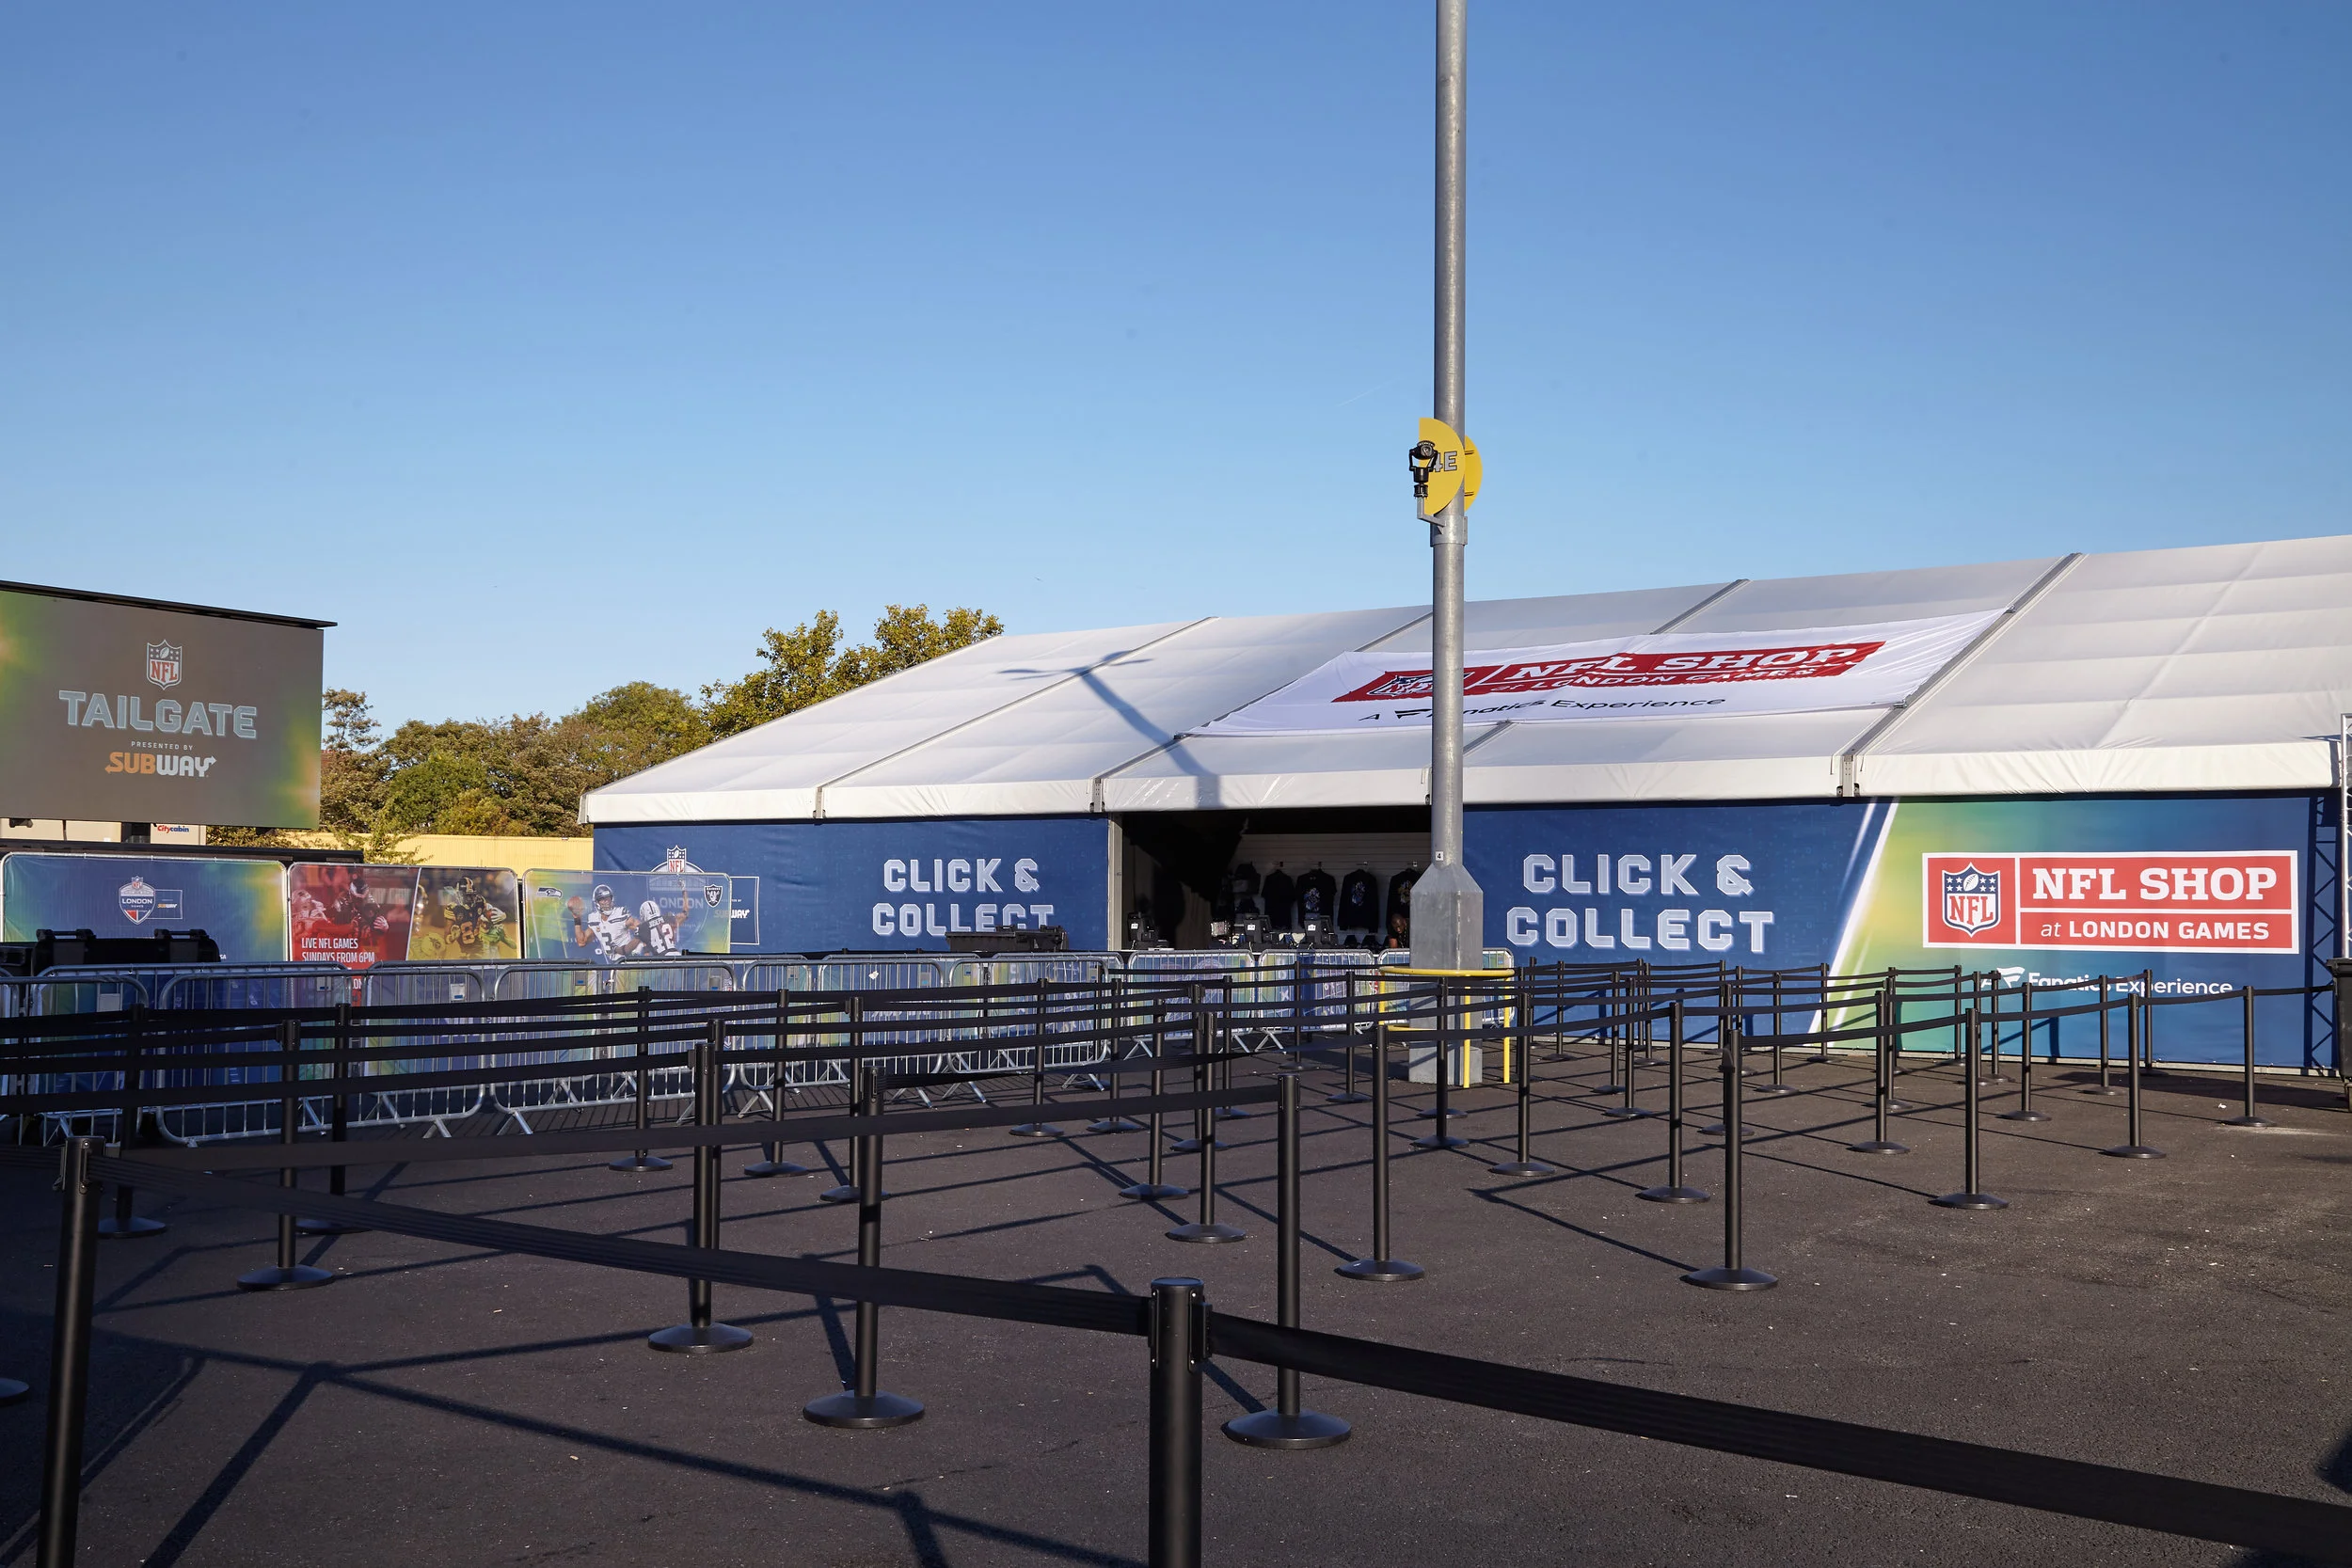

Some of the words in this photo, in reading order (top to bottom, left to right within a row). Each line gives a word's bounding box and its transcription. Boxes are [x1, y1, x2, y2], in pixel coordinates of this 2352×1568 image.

[151, 660, 178, 683] NFL
[1504, 656, 1637, 680] NFL
[1654, 649, 1857, 671] SHOP
[1531, 675, 1677, 688] LONDON
[59, 690, 257, 738] TAILGATE
[1426, 700, 1546, 717] natics
[1550, 699, 1725, 710] Experience
[132, 741, 180, 750] PRESENTED
[105, 752, 216, 777] SUBWAY
[157, 825, 189, 833] Citycabin
[669, 860, 685, 873] NFL
[883, 858, 1003, 893] CLICK
[1014, 858, 1041, 893] &
[1523, 853, 1699, 895] CLICK
[1716, 854, 1755, 895] &
[2033, 867, 2126, 900] NFL
[2139, 867, 2277, 901] SHOP
[872, 903, 1054, 936] COLLECT
[1949, 895, 1994, 927] NFL
[1506, 907, 1774, 953] COLLECT
[2041, 922, 2061, 937] at
[2070, 921, 2169, 939] LONDON
[2178, 922, 2269, 940] GAMES
[301, 938, 317, 949] LIVE
[319, 938, 332, 949] NFL
[333, 938, 358, 949] GAMES
[302, 952, 336, 961] SUNDAYS
[337, 952, 358, 963] FROM
[358, 952, 375, 963] 6PM
